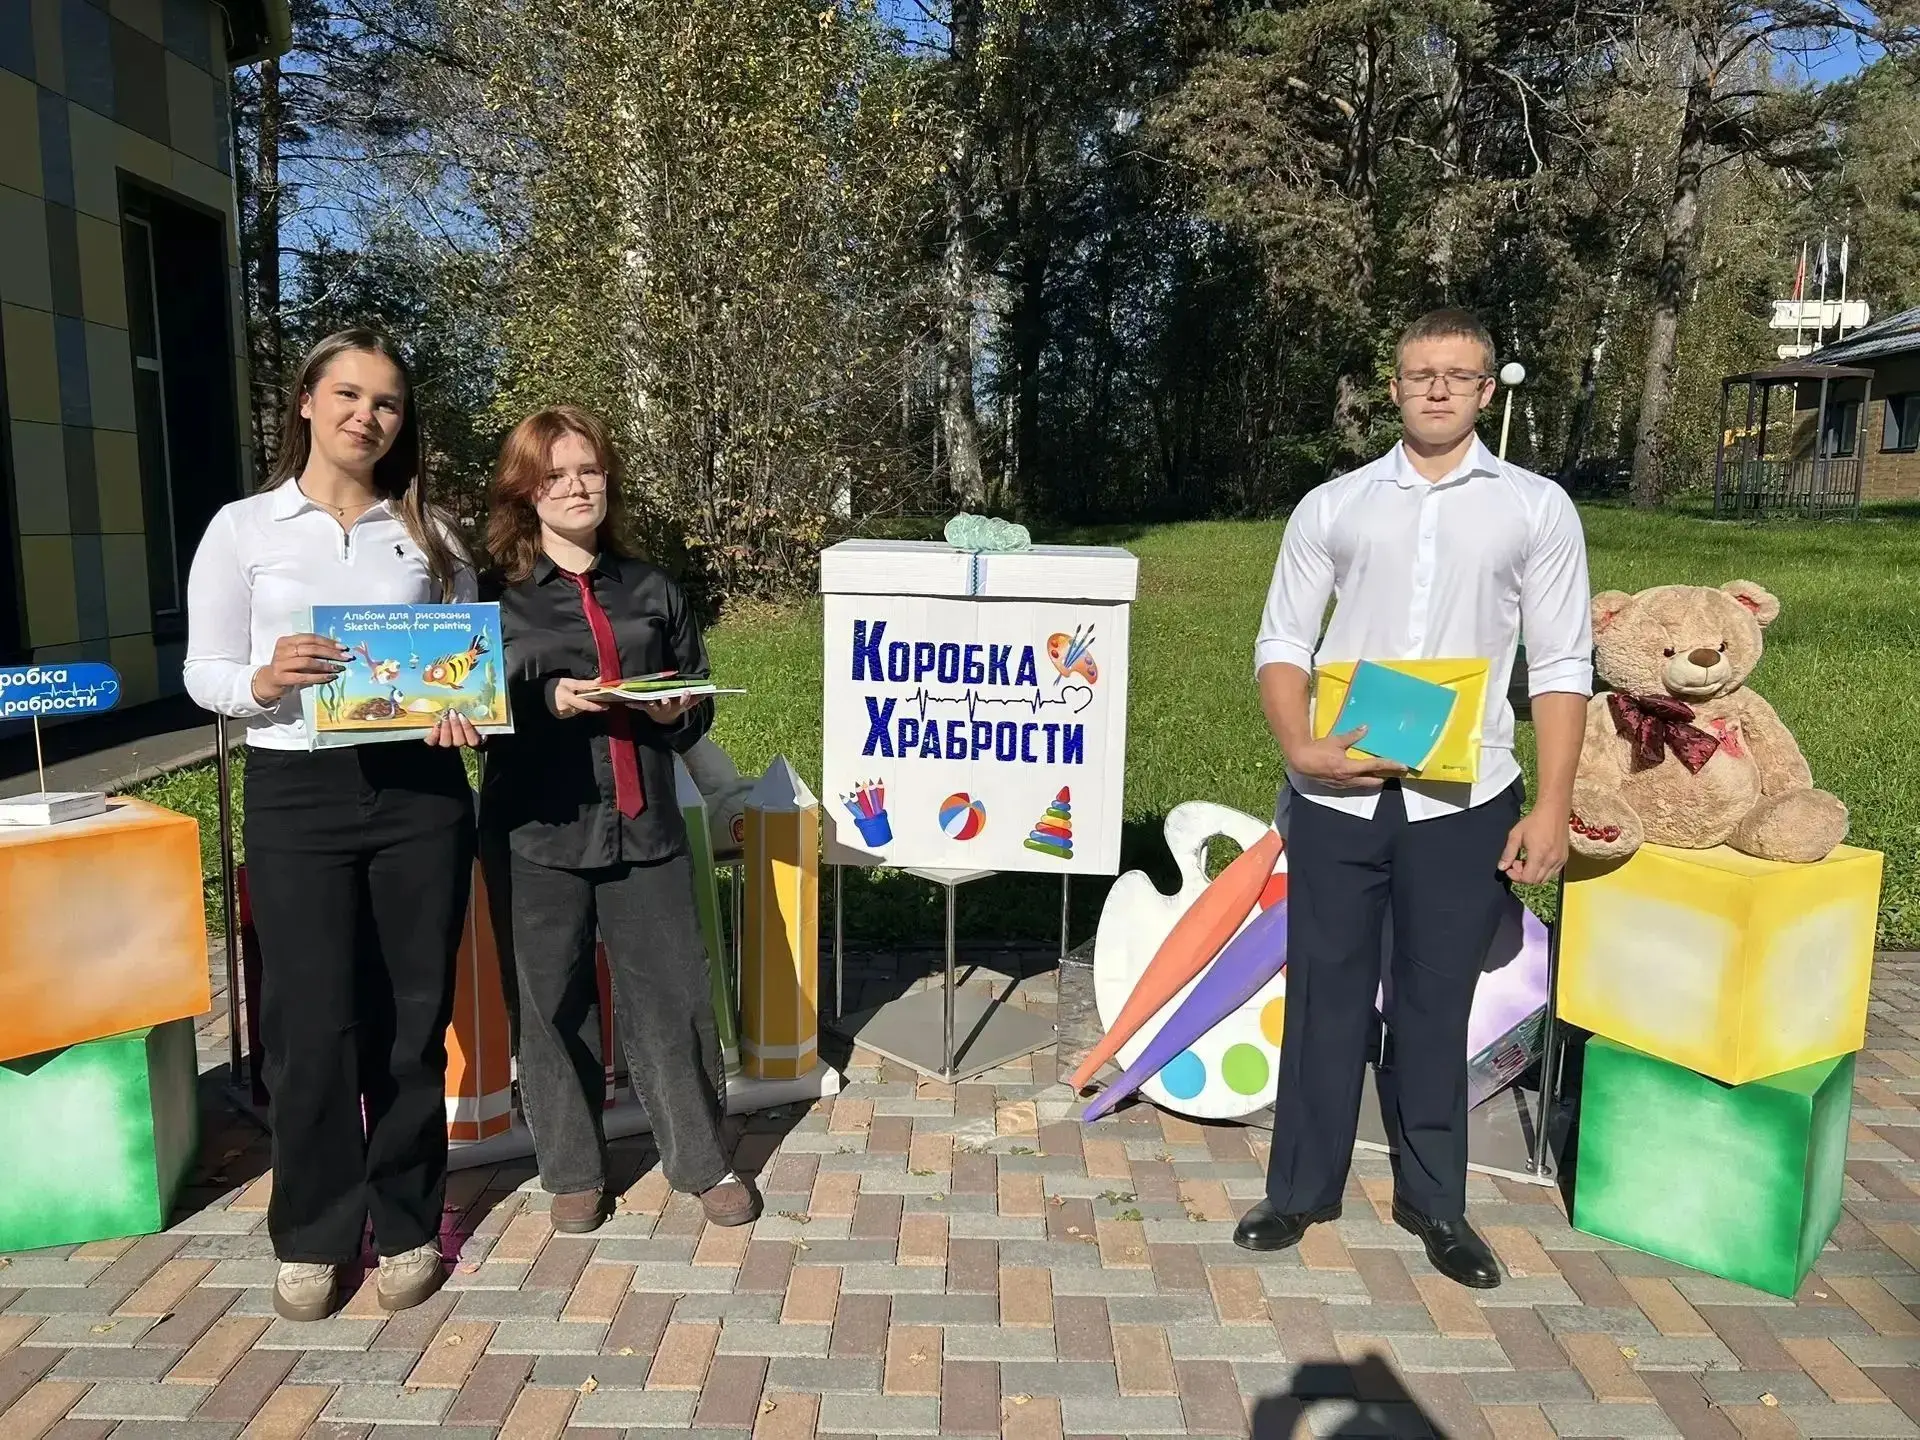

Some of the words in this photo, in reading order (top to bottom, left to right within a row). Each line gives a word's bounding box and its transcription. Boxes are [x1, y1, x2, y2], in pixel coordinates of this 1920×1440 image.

[343, 611, 386, 621] Альбом
[389, 612, 409, 621] для
[415, 612, 471, 622] рисования
[343, 621, 409, 631] Sketch-book
[412, 620, 430, 630] for
[433, 621, 472, 632] painting
